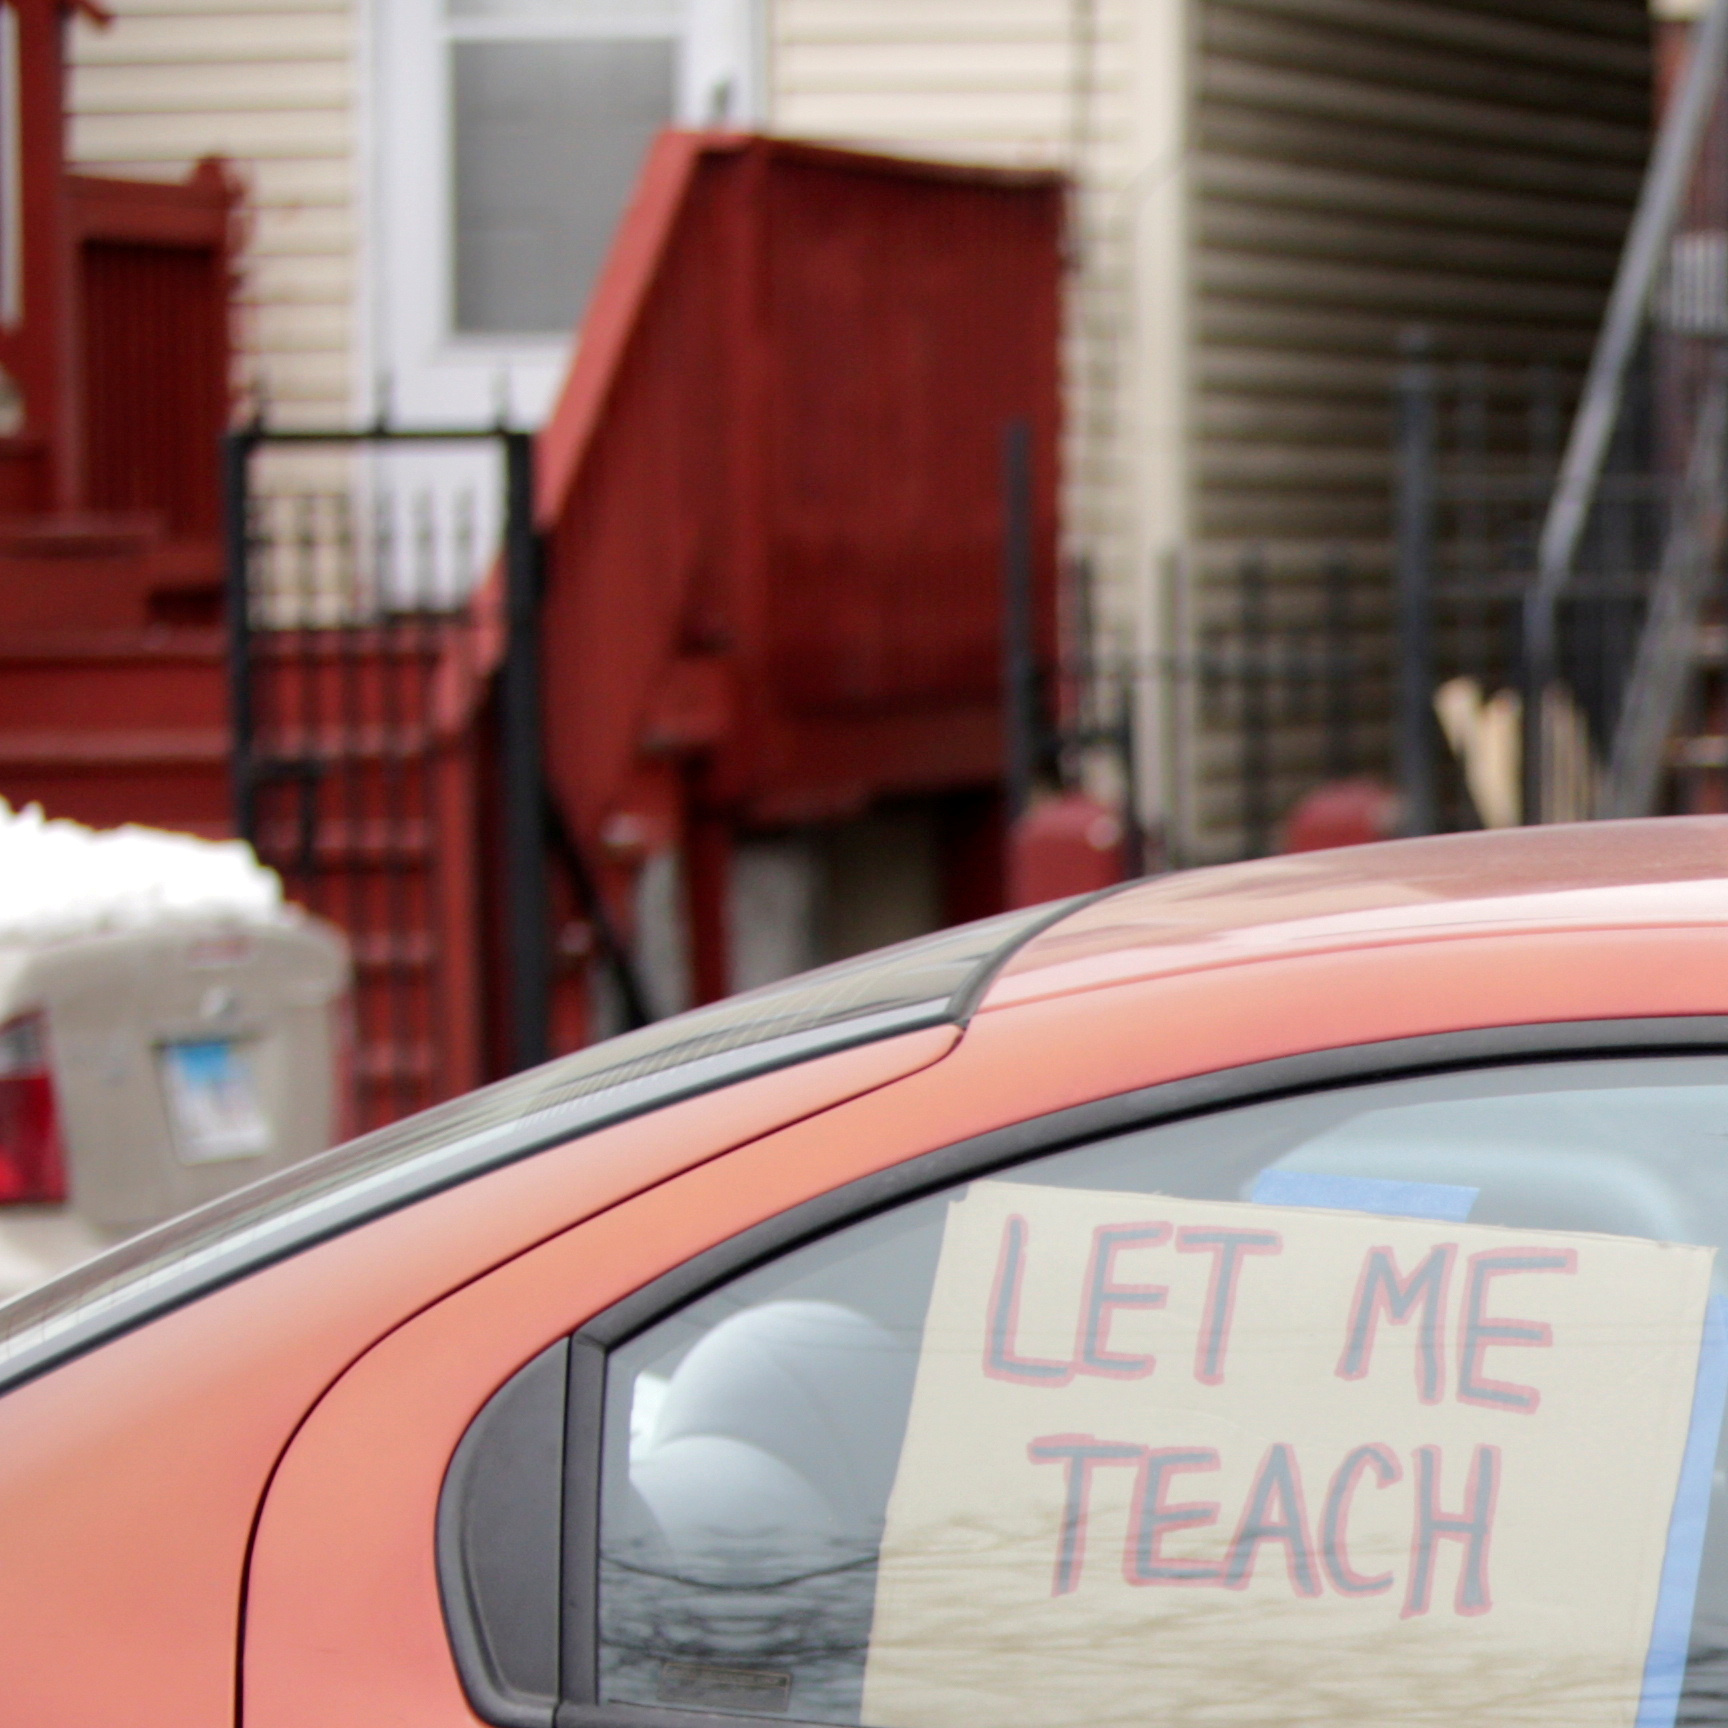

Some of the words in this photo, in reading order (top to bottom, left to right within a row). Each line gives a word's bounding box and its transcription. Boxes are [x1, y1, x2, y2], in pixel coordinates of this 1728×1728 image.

[982, 1213, 1283, 1388] LET
[1334, 1242, 1579, 1416] ME
[1026, 1433, 1502, 1620] TEACH
